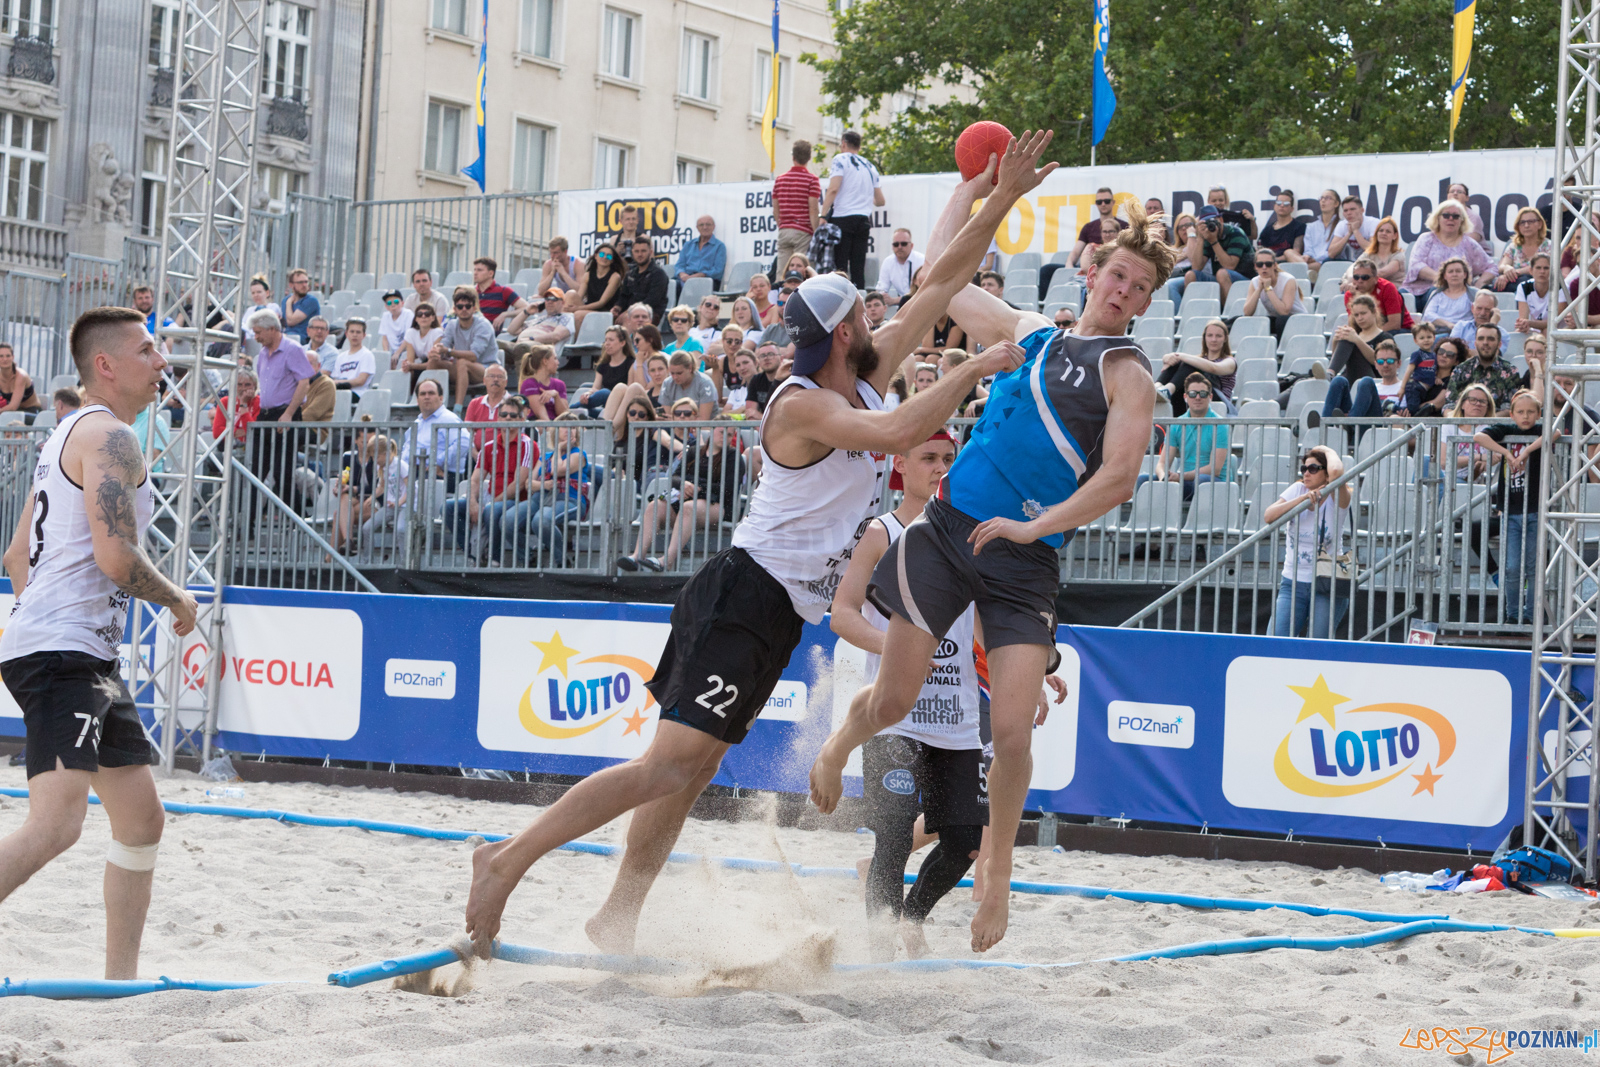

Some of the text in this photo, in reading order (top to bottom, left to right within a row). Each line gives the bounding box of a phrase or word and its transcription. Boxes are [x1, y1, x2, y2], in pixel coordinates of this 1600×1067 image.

[745, 192, 773, 209] BEA
[740, 215, 777, 233] BEAC
[232, 656, 334, 689] VEOLIA
[394, 672, 443, 687] POZnan
[548, 671, 631, 721] LOTTO
[694, 674, 739, 719] 22
[1118, 716, 1179, 734] POZnan
[1309, 722, 1420, 778] LOTTO
